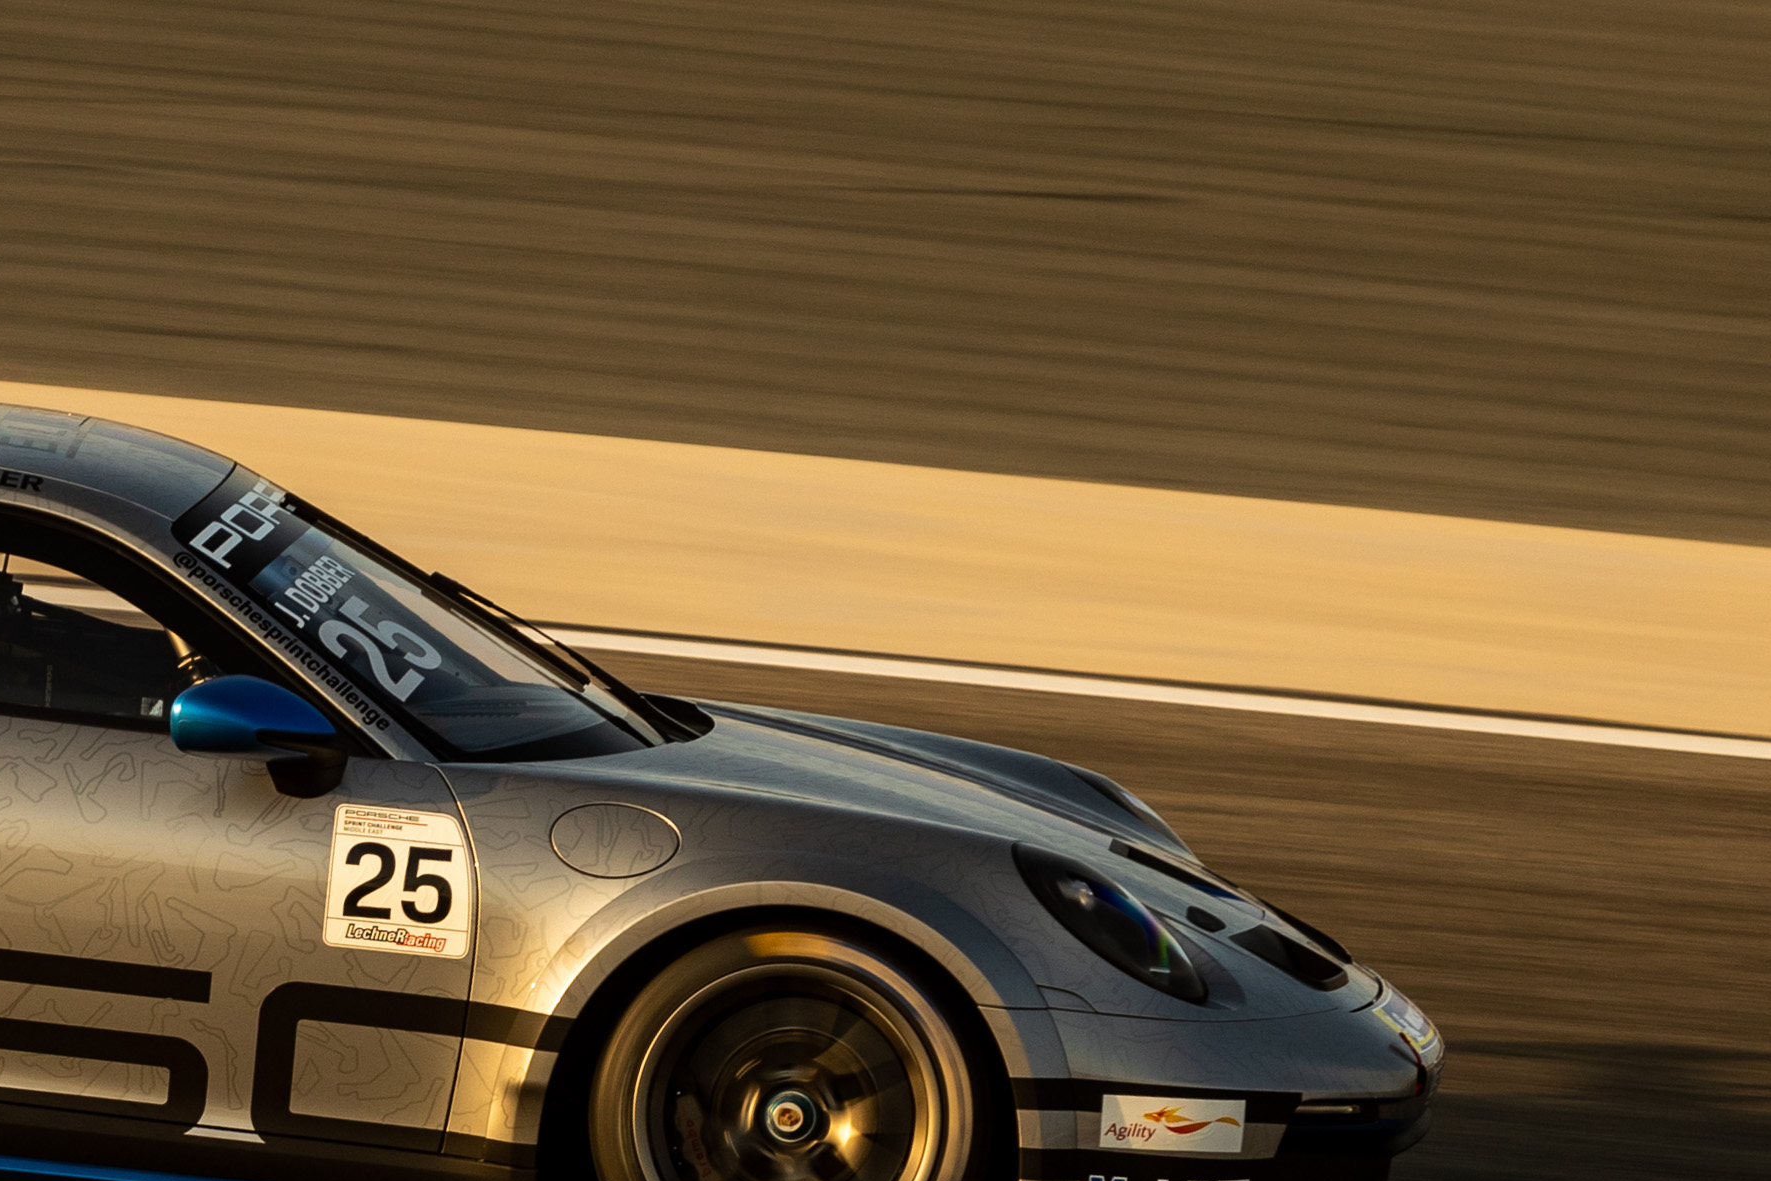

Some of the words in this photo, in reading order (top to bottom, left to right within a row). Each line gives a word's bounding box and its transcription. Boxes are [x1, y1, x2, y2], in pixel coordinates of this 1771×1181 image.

[284, 555, 356, 614] DOBBER
[172, 551, 390, 732] @porschesprintchallenge
[318, 596, 442, 702] 25
[344, 820, 366, 828] SPRINT
[367, 822, 403, 831] CHALLENGE
[345, 810, 419, 821] PORSCHE
[342, 841, 453, 924] 25
[1104, 1122, 1157, 1142] Agility
